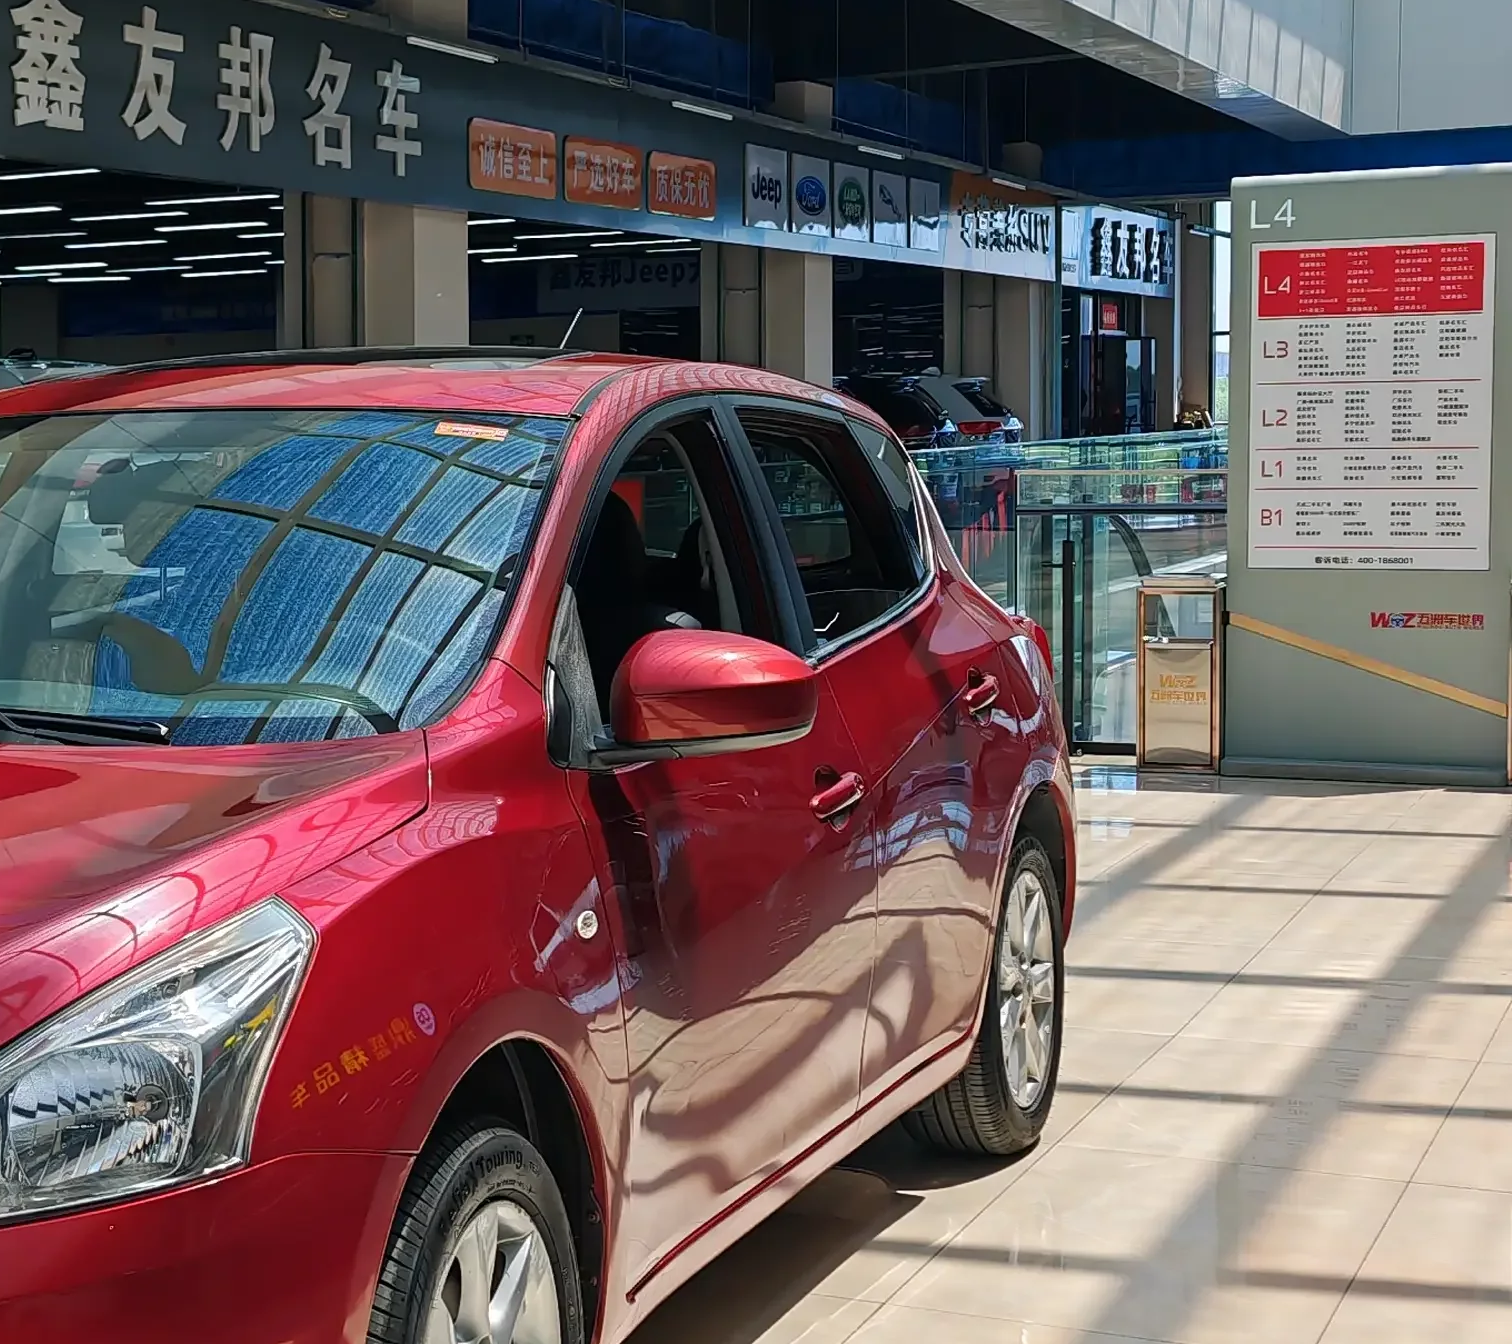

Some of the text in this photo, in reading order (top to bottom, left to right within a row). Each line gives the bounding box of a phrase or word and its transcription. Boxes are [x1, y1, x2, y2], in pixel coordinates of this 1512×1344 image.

[478, 133, 550, 186] 诚信至上
[573, 149, 637, 196] 严选好车
[655, 164, 711, 209] 质保无忧
[751, 167, 782, 210] Jeep
[1250, 198, 1296, 229] L4
[1263, 275, 1291, 295] L4
[1262, 340, 1289, 359] L3
[1261, 409, 1288, 428] L2
[1260, 460, 1284, 478] L1
[1260, 508, 1284, 527] B1
